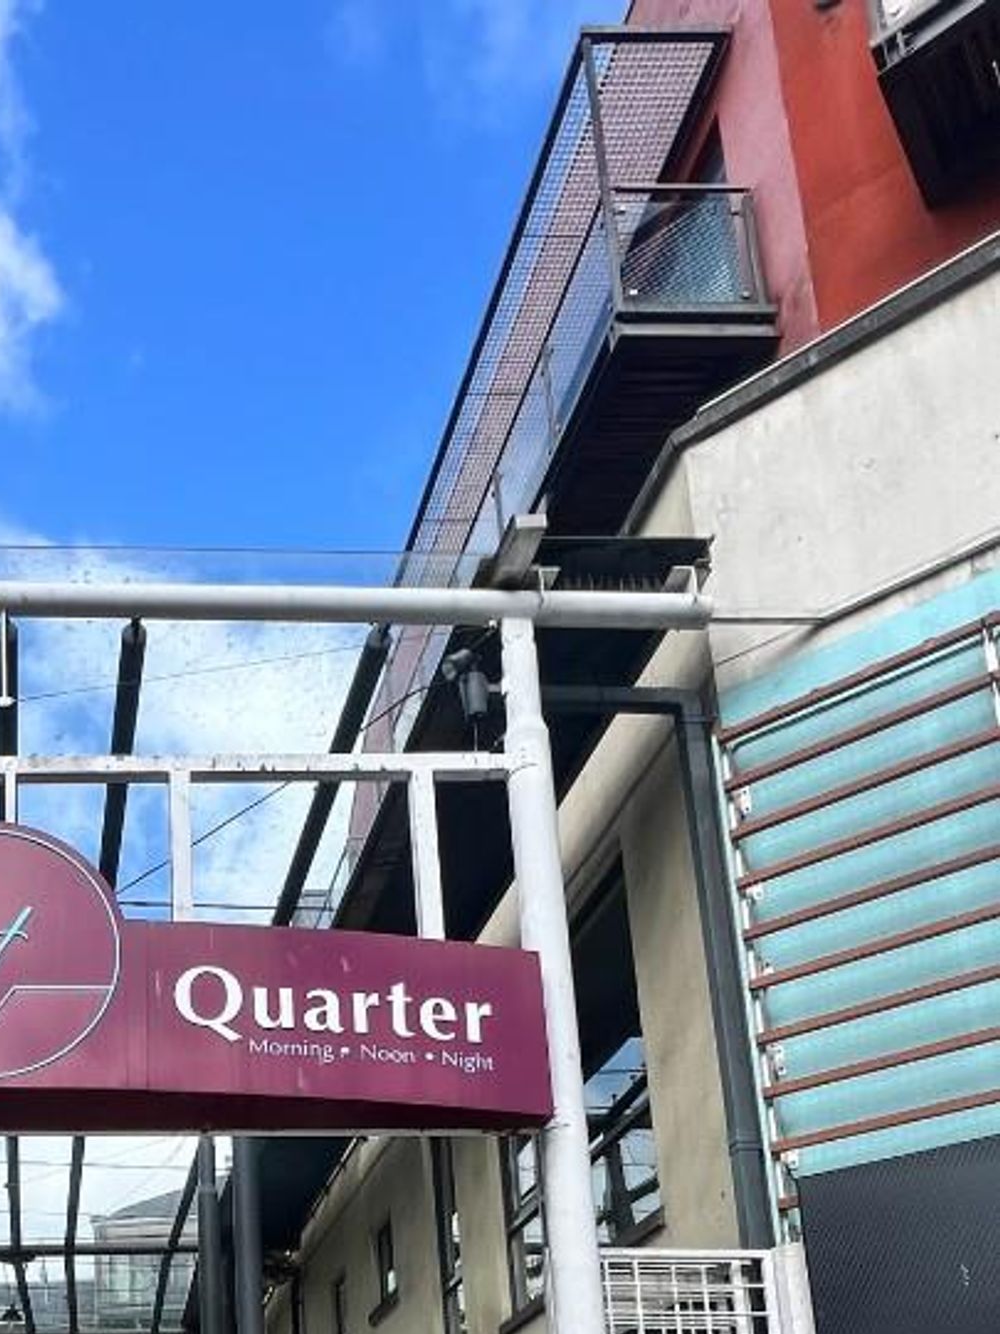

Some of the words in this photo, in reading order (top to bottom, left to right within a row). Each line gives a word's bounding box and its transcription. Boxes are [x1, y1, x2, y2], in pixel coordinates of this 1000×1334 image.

[174, 965, 493, 1043] Quarter
[248, 1038, 335, 1063] Morning
[359, 1044, 416, 1063] Noon
[441, 1050, 494, 1073] Night
